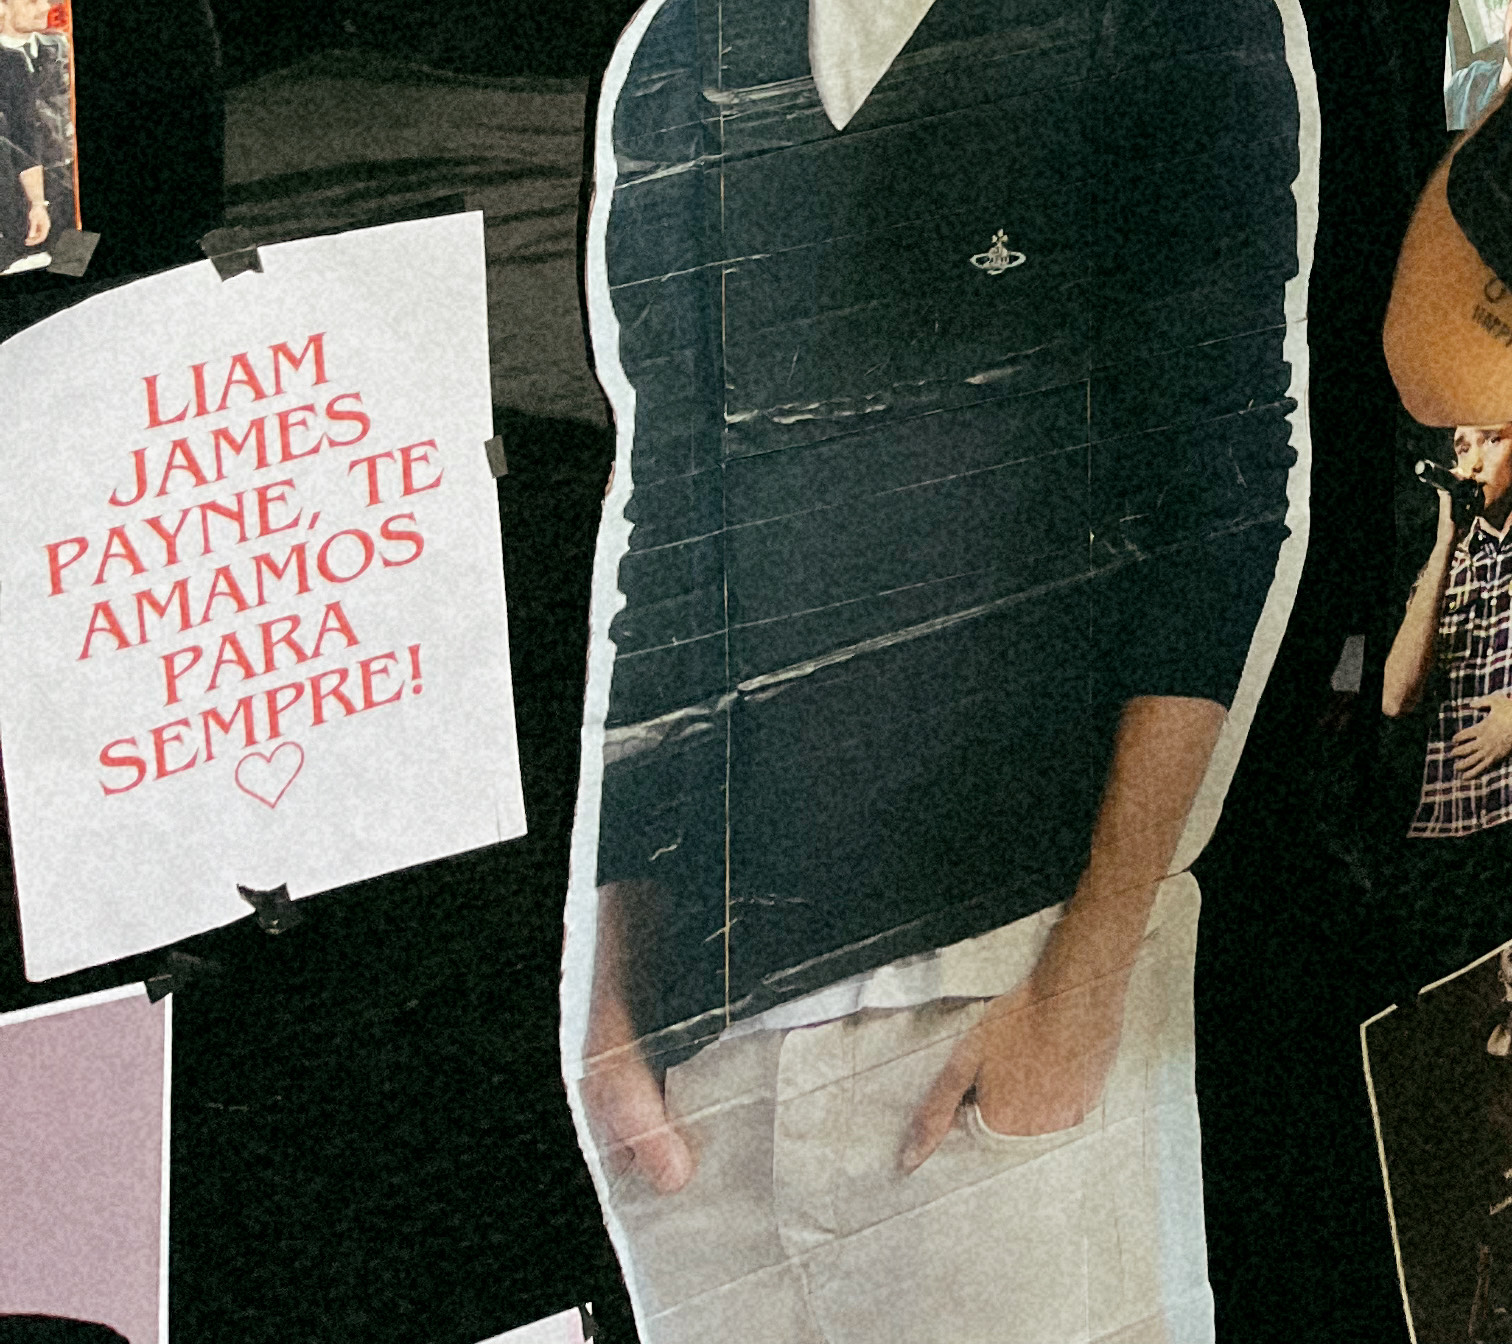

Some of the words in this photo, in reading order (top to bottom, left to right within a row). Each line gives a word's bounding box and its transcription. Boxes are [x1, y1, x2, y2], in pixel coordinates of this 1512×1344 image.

[142, 331, 330, 430] LIAM
[107, 392, 372, 508] JAMES
[43, 478, 320, 597] PAYNE,
[347, 439, 444, 507] TE
[77, 512, 424, 661] AMAMOS
[161, 600, 360, 707] PARA
[99, 643, 423, 797] SEMPRE!
